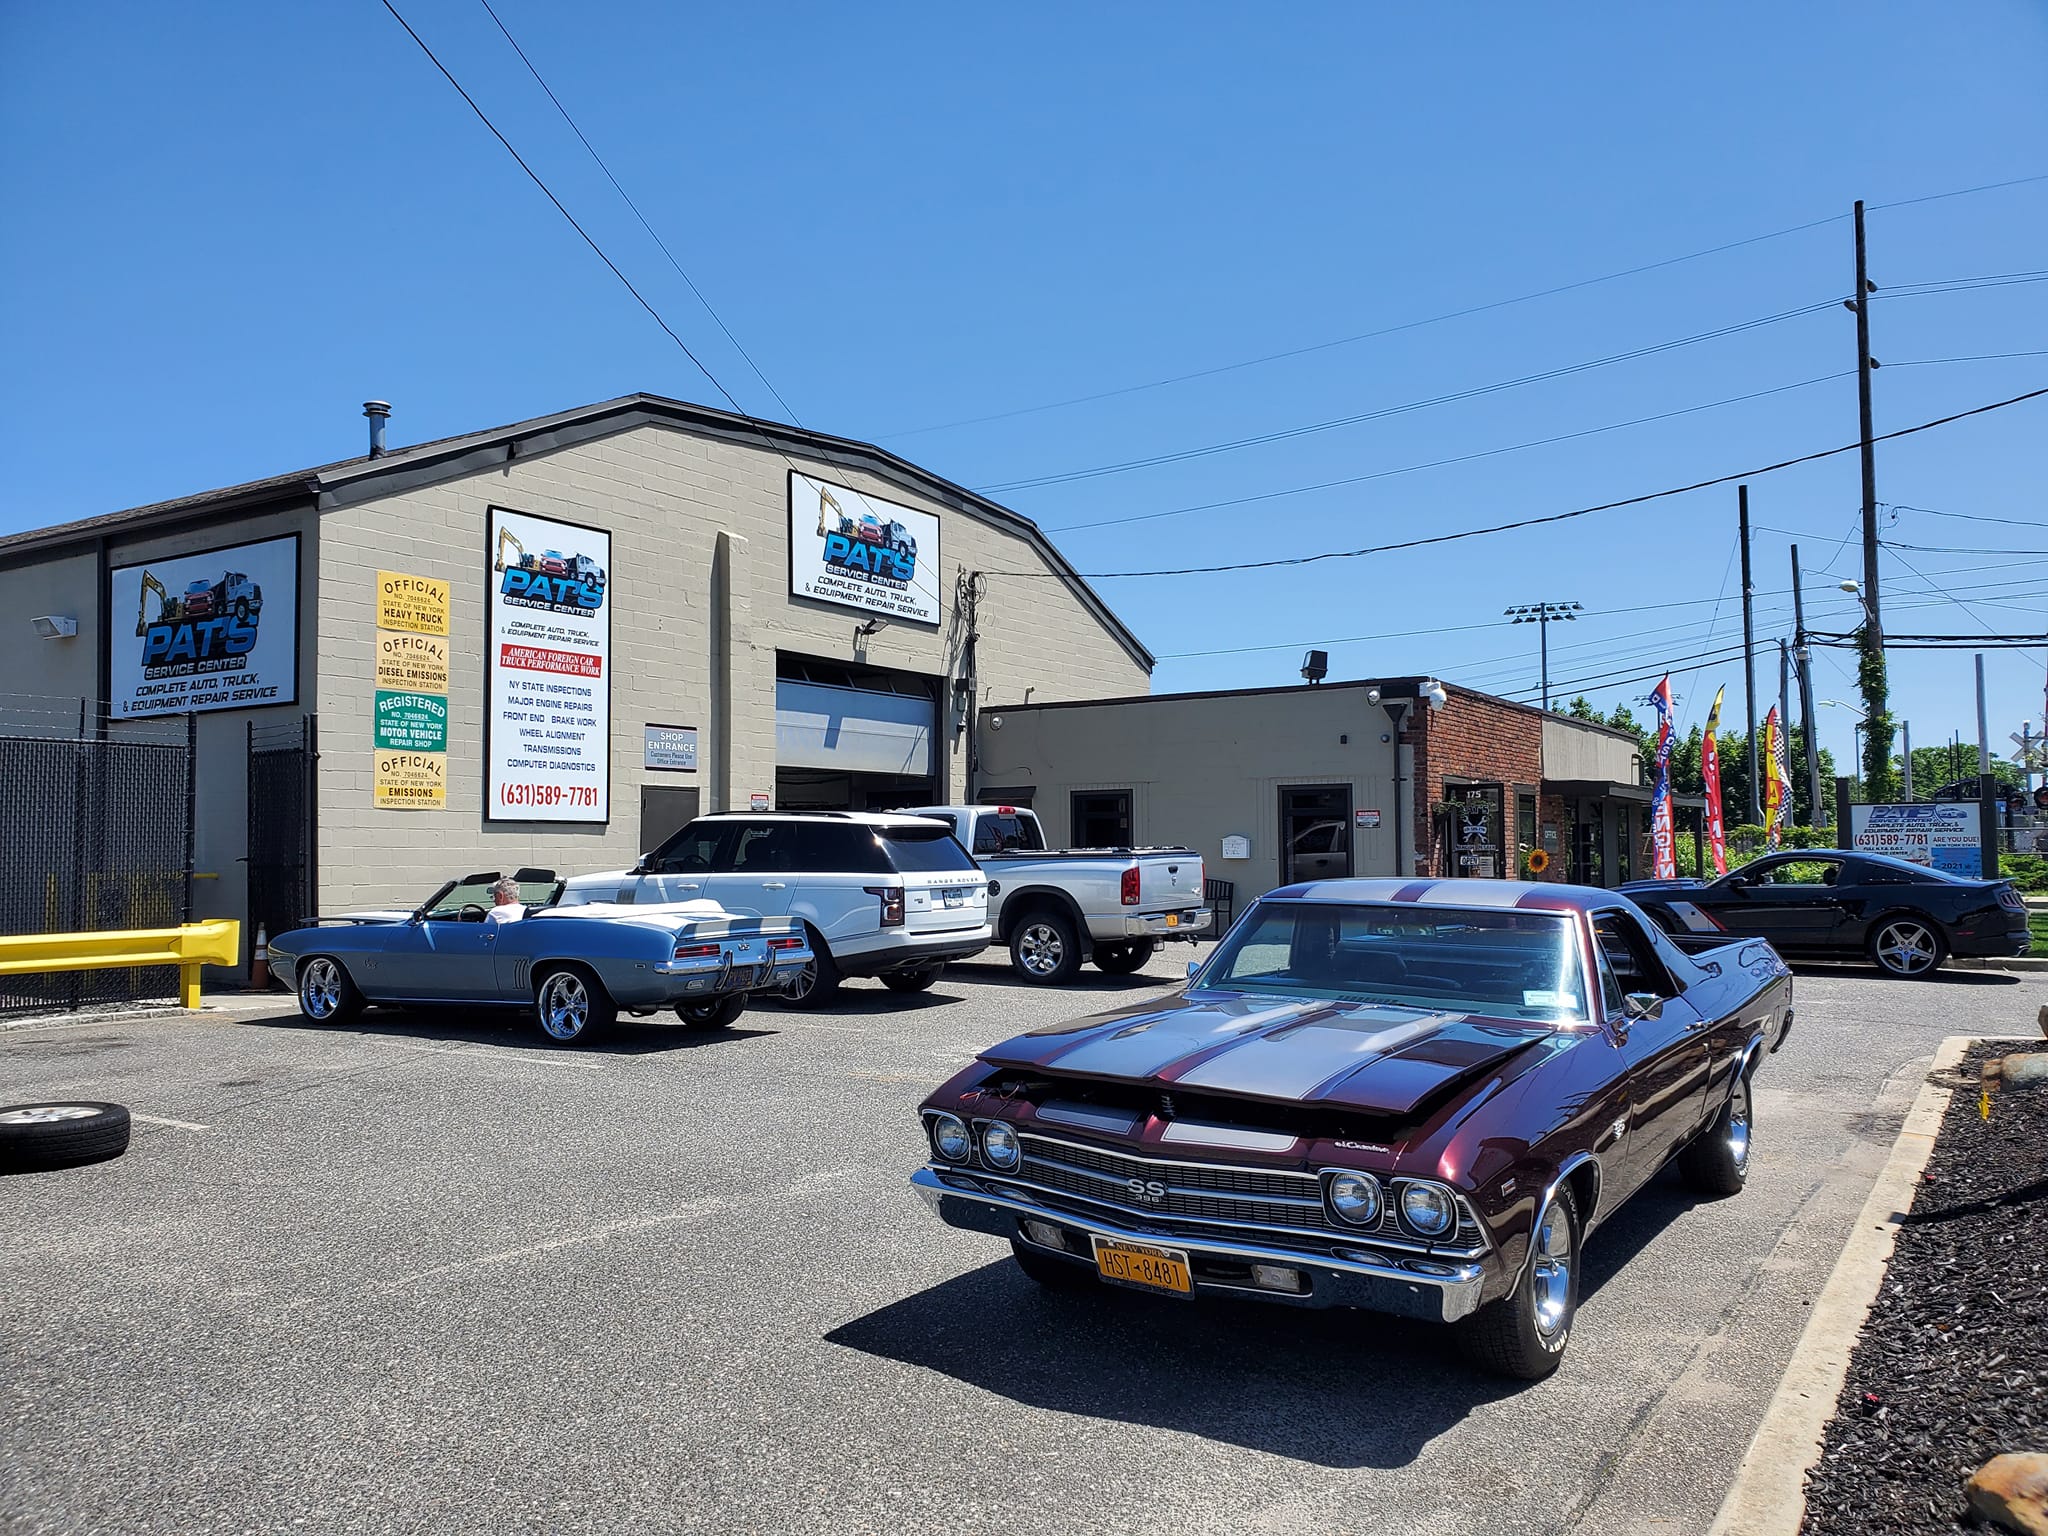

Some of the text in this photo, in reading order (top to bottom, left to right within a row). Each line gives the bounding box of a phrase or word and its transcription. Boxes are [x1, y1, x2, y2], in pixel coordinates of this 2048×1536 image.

[824, 533, 915, 580] PAT'S
[826, 564, 908, 591] SERVICE CENTER
[384, 580, 444, 603] OFFICIAL
[501, 569, 604, 609] PAT'S
[817, 576, 863, 593] COMPLETE
[890, 593, 917, 605] TRUCK,
[504, 596, 594, 617] SERVICE CENTER
[805, 582, 929, 618] & EQUIPMENT REPAIR SERVICE
[384, 608, 443, 624] HEAVY TRUCK
[414, 604, 427, 612] NEW
[429, 606, 445, 614] YORK
[384, 619, 444, 632] INSPECTION STATION
[511, 621, 546, 632] COMPLETE
[142, 616, 258, 665] PAT'S
[507, 628, 546, 640] EQUIPMENT
[547, 634, 572, 643] REPAIR
[573, 637, 600, 647] SERVICE
[383, 638, 443, 660] OFFICIAL
[508, 647, 594, 666] AMERICAN FOREIGN CAR
[145, 656, 246, 678] SERVICE CENTER
[382, 659, 400, 667] STATE
[502, 656, 600, 676] TRUCK PERFORMANCE WORK
[378, 666, 447, 682] DIESEL EMISSIONS
[136, 673, 260, 697] COMPLETE AUTO, TRUCK,
[382, 678, 443, 690] INSPECTION STATION
[509, 680, 592, 697] NY STATE INSPECTIONS
[122, 686, 278, 712] & EQUIPMENT REPAIR SERVICE
[379, 696, 445, 718] REGISTERED
[508, 696, 593, 712] MAJOR ENGINE REPAIRS
[410, 721, 425, 729] NEW
[426, 722, 443, 730] YORK
[503, 711, 597, 727] FRONT END BRAKE WORK
[380, 727, 442, 740] MOTOR VEHICLE
[519, 728, 586, 741] WHEEL ALIGNMENT
[660, 732, 683, 741] SHOP
[390, 738, 432, 748] REPAIR SHOP
[523, 744, 582, 756] TRANSMISSIONS
[648, 741, 695, 752] ENTRANCE
[381, 756, 441, 777] OFFICIAL
[507, 758, 596, 772] COMPUTER DIAGNOSTICS
[389, 787, 433, 797] EMISSIONS
[501, 782, 598, 807] (631)589-7781
[1466, 790, 1481, 799] 175
[380, 798, 415, 806] INSPECTION
[1854, 834, 1929, 846] (631)589-7781
[1128, 1179, 1165, 1197] SS
[1135, 1194, 1160, 1203] 396
[1116, 1243, 1164, 1258] NEW YORK
